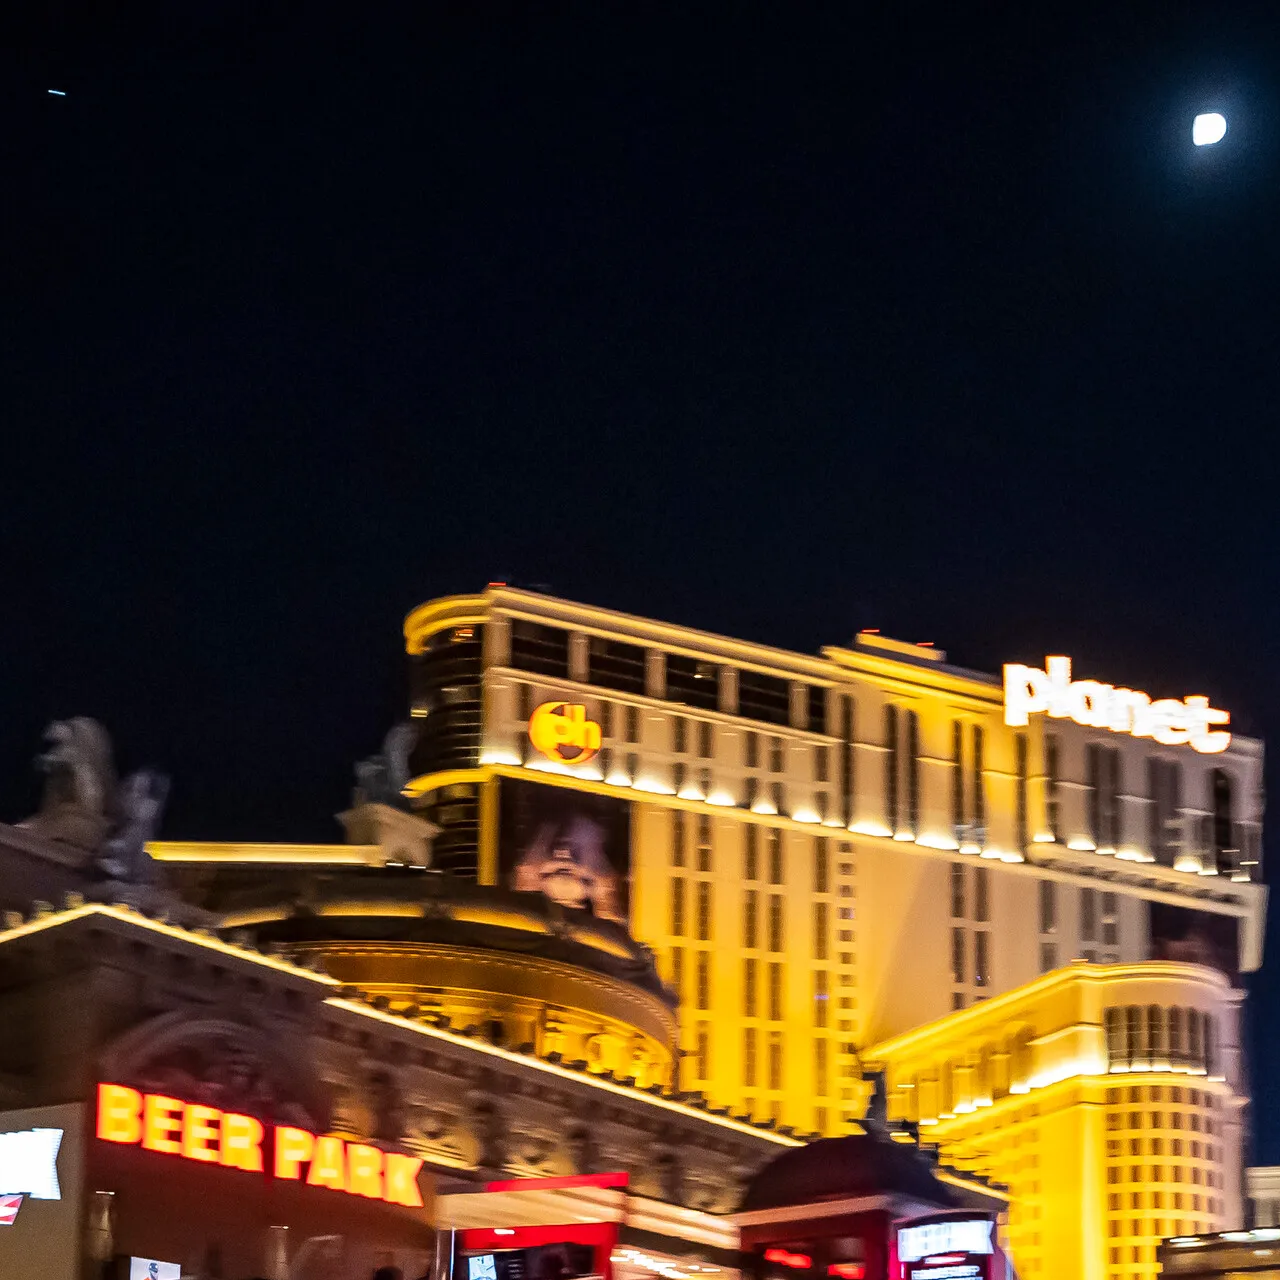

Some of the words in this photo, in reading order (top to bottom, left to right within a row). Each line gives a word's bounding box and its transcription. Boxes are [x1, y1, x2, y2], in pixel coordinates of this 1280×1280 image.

[1003, 655, 1232, 754] planet
[96, 1082, 265, 1173] BEER
[273, 1125, 424, 1208] PARK
